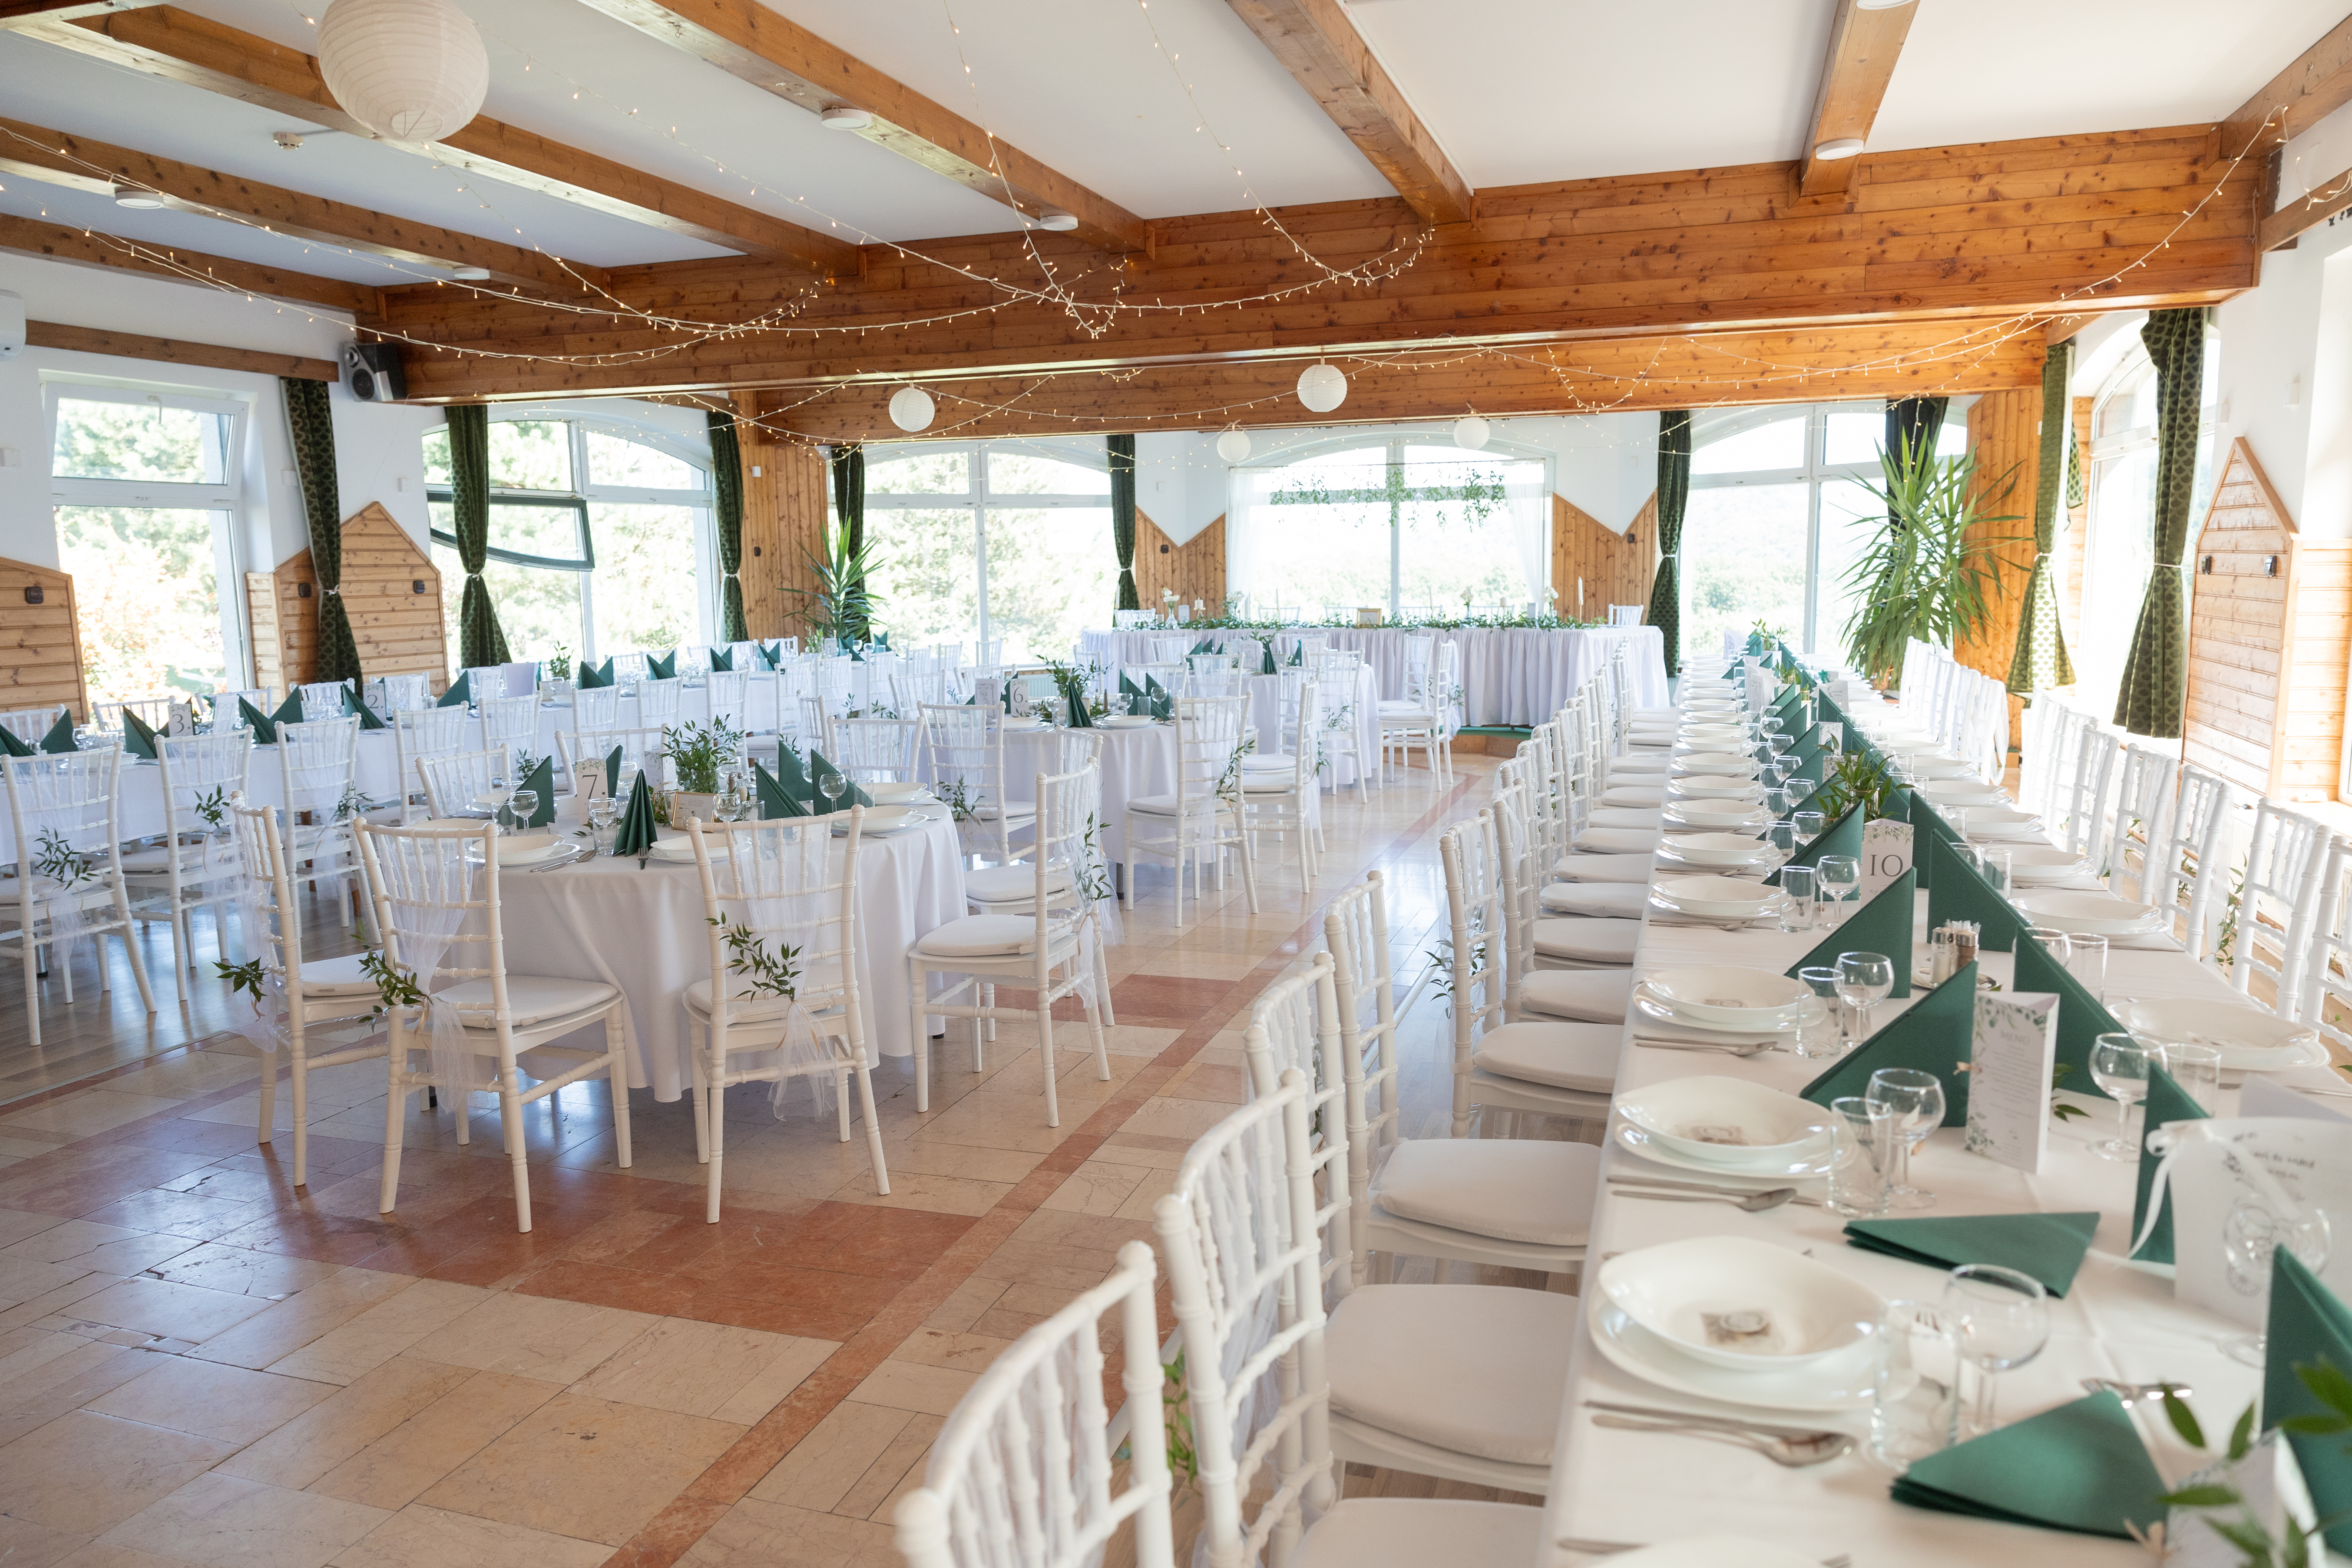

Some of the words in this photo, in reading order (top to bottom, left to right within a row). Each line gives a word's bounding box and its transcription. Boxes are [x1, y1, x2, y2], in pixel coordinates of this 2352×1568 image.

[367, 695, 383, 708] 2.
[1014, 687, 1027, 703] 6.
[172, 714, 190, 734] 3.
[582, 774, 605, 799] 7.
[1869, 854, 1903, 877] 10
